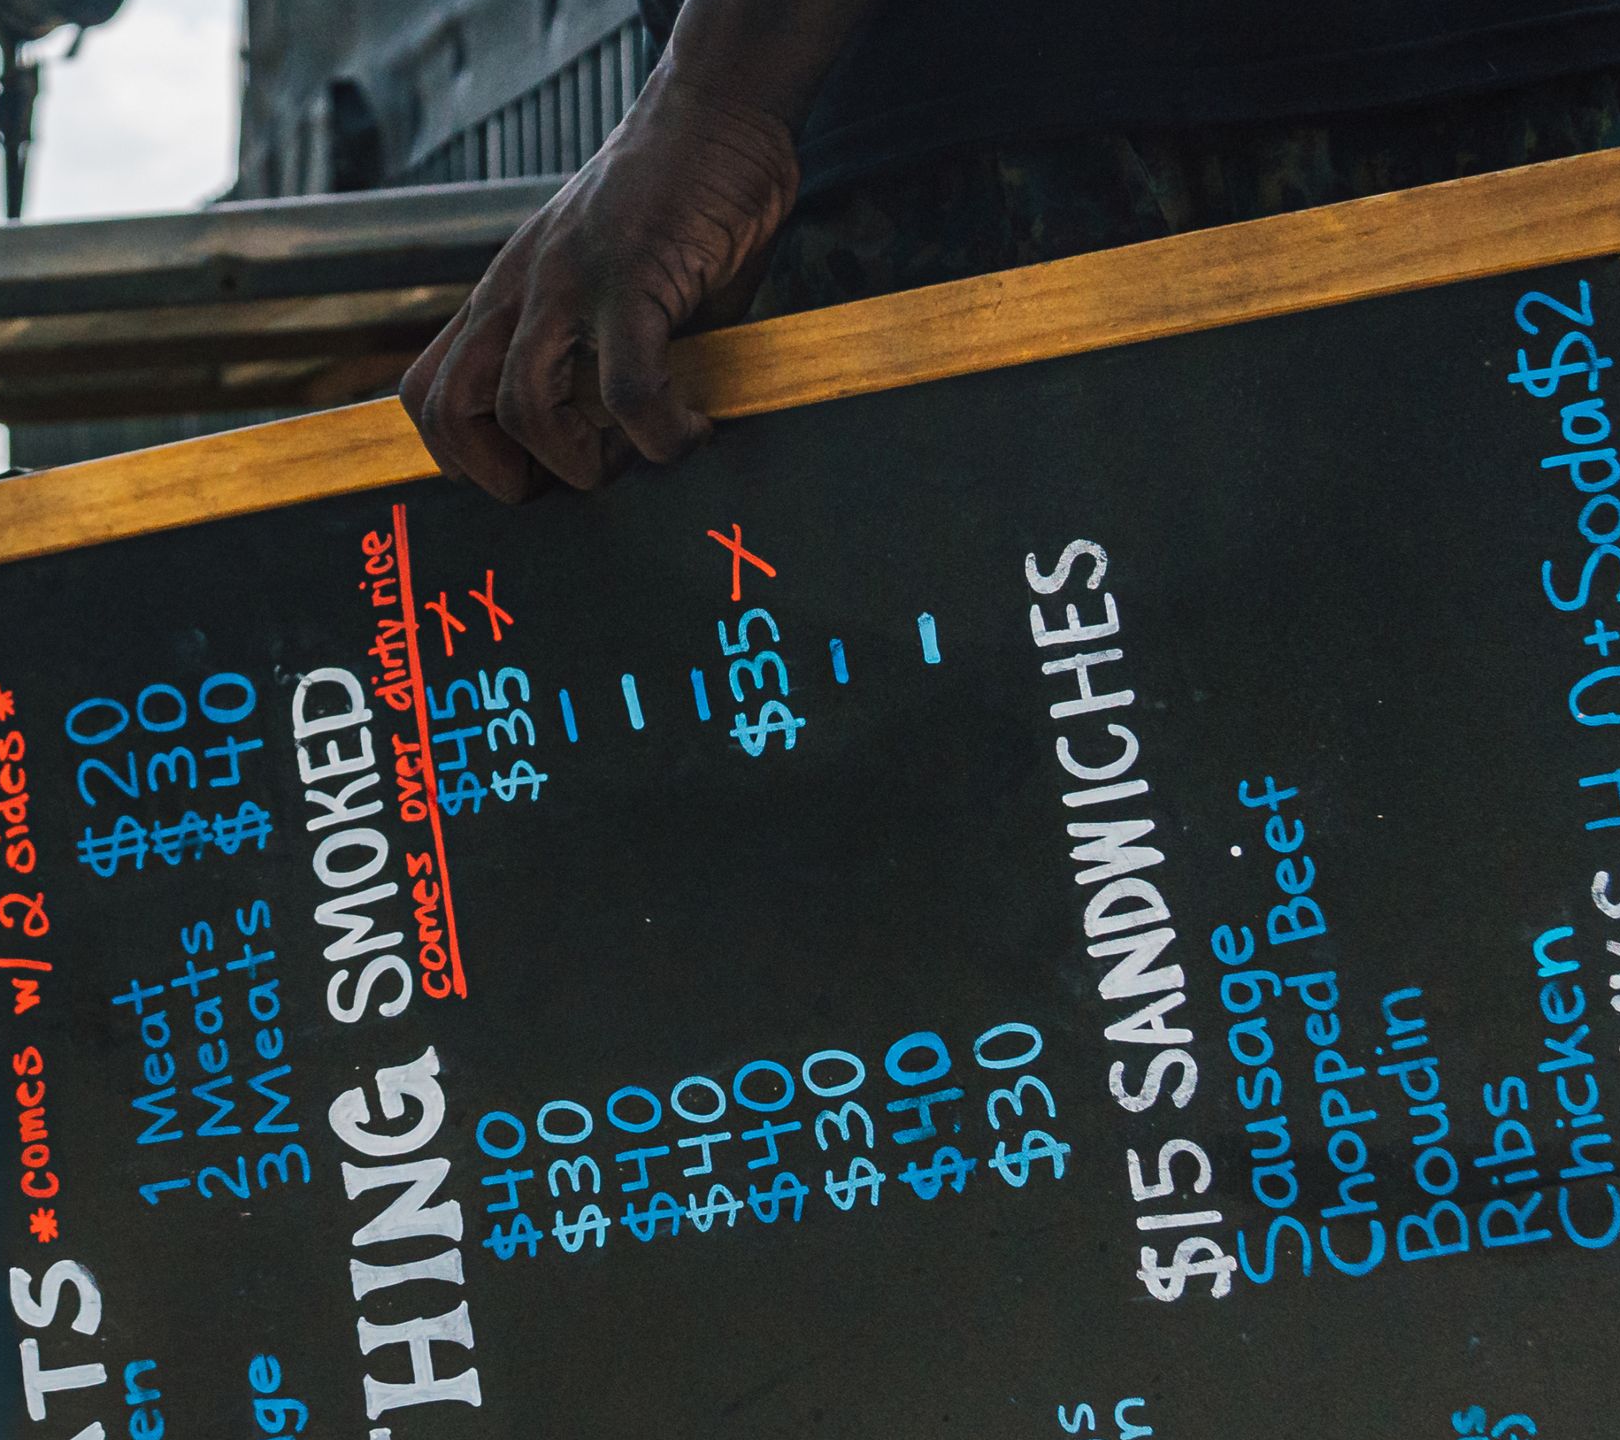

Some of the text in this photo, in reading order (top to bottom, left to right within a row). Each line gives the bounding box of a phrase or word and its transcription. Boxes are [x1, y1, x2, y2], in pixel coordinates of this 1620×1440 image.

[195, 673, 273, 860] $40
[360, 531, 447, 999] comes over dirty rice
[426, 679, 488, 816] $45
[478, 667, 548, 802] $35
[718, 608, 806, 757] $35
[292, 668, 412, 1023] SMOKED
[1022, 539, 1237, 1302] $15 SANDWICHES
[65, 698, 191, 1205] 1 Meat $20
[136, 684, 251, 1199] 2 Meats $30
[226, 900, 300, 1134] Meats
[1238, 776, 1386, 1277] Chopped Beef
[476, 1111, 544, 1260] $40
[536, 1100, 611, 1253] $30
[607, 1085, 685, 1242] $40
[670, 1076, 744, 1233] $40
[732, 1060, 809, 1223] $40
[802, 1050, 886, 1211] $30
[884, 1031, 977, 1200] $40
[973, 1022, 1071, 1188] $30
[1211, 925, 1313, 1284] Sausage
[1375, 987, 1470, 1262] Boudin
[1474, 1076, 1552, 1248] Ribs
